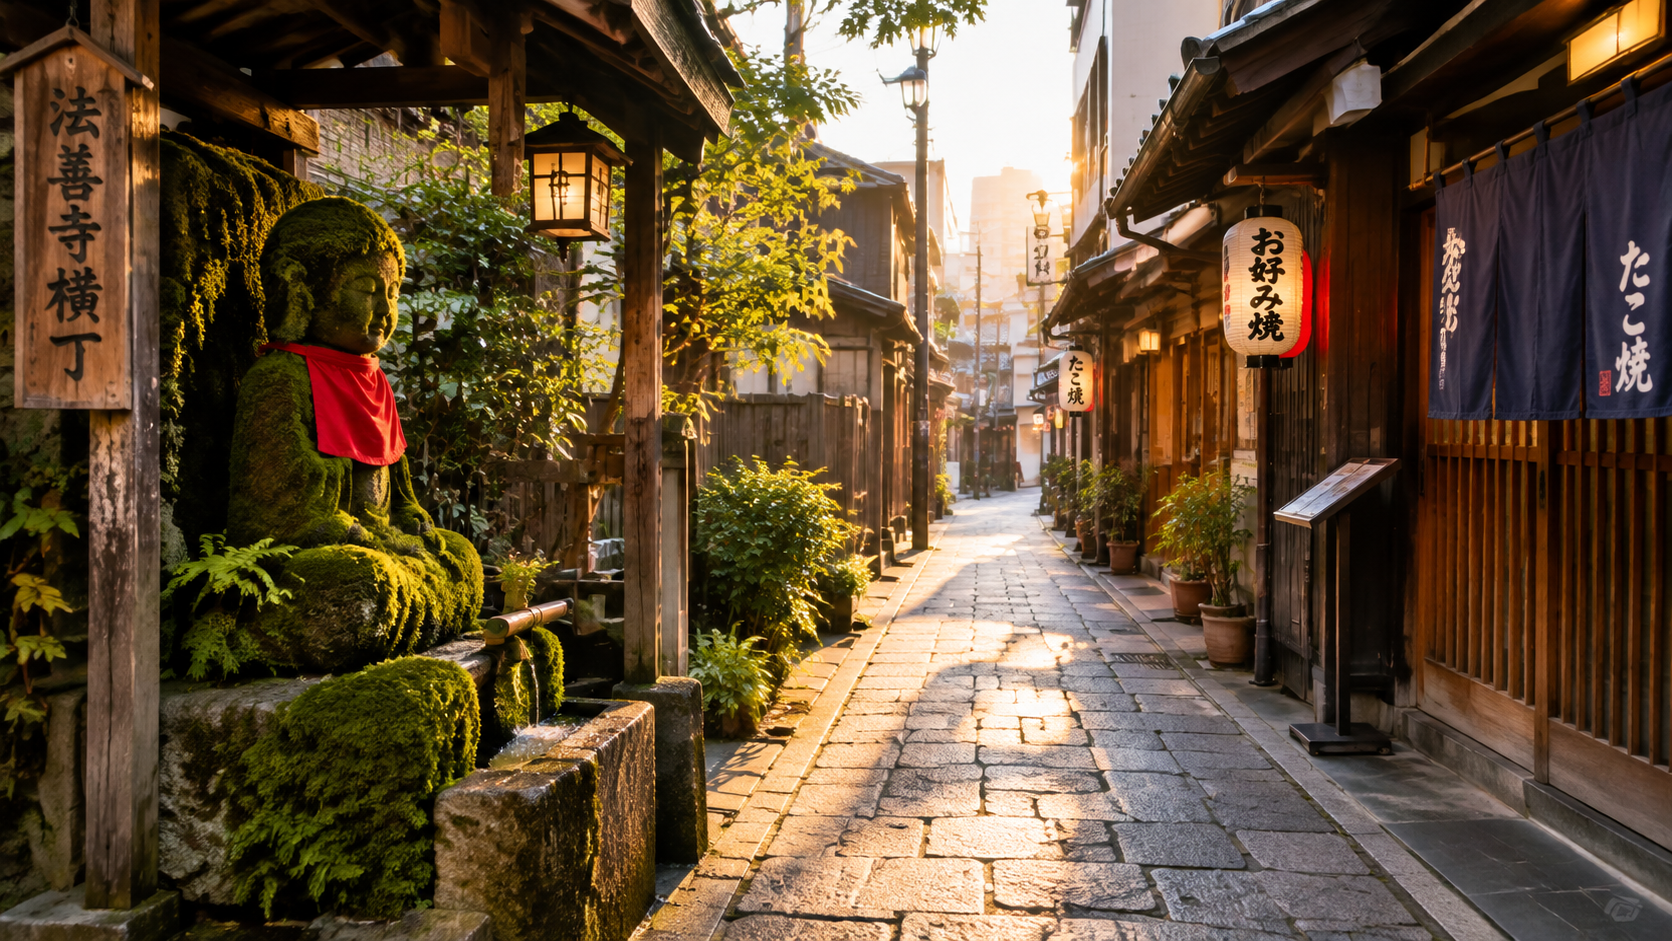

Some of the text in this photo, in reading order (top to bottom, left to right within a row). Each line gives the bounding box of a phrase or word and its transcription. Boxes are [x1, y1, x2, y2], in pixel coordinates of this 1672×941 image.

[45, 86, 103, 381] 法善寺横丁
[1248, 227, 1285, 342] お好み焼
[1067, 354, 1085, 406] たこ焼
[1615, 240, 1653, 393] たこ焼
